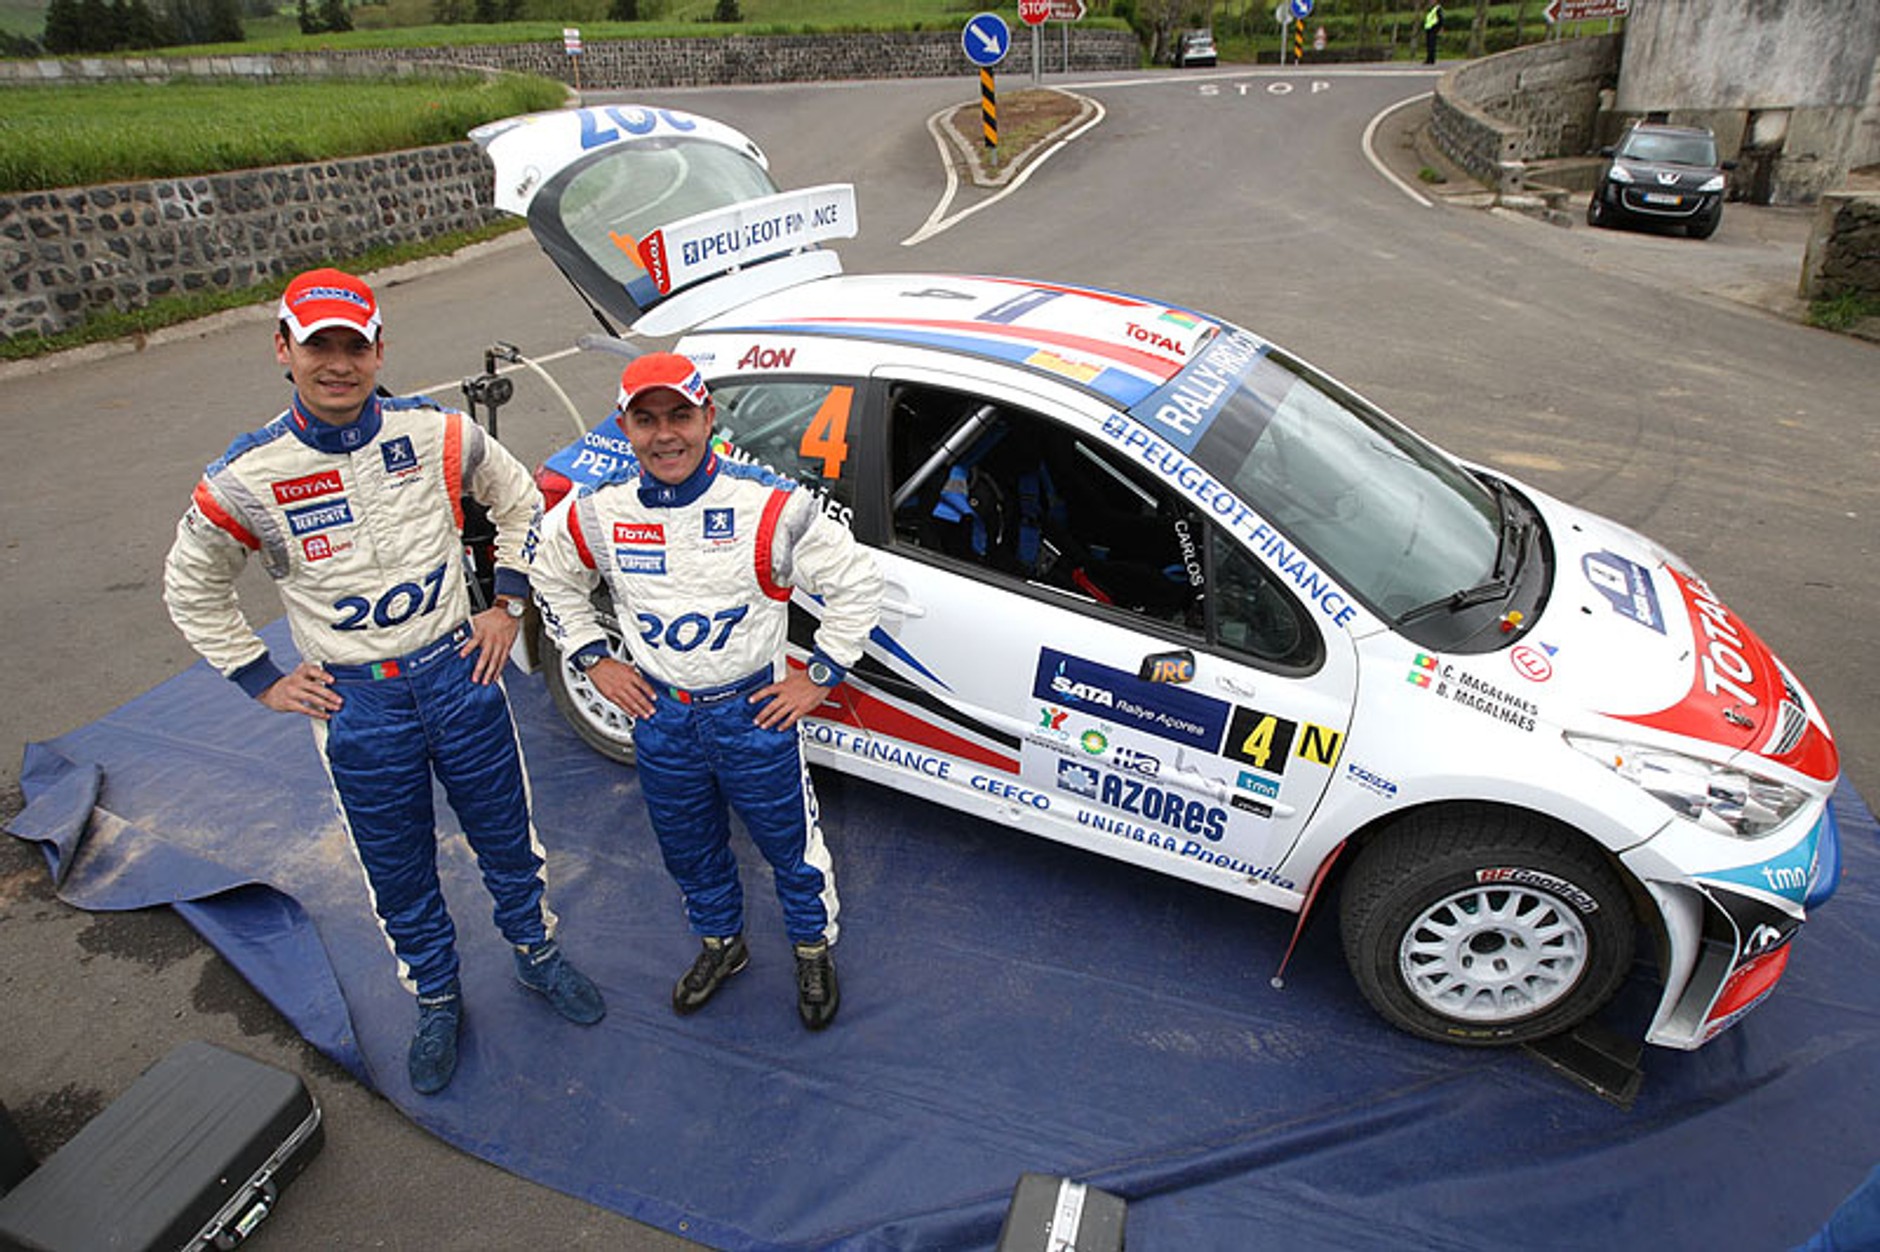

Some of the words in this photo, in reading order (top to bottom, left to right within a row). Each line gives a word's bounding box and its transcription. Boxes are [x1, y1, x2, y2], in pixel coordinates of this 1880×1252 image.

[1199, 81, 1330, 96] STOP
[648, 235, 664, 290] TOTAL
[1126, 322, 1187, 357] TOTAL
[799, 385, 855, 479] 4
[276, 479, 340, 499] TOTAL
[616, 526, 662, 541] TOTAL
[1124, 430, 1254, 528] PEUGEOT
[1248, 524, 1357, 628] FINANCE
[1175, 520, 1205, 587] CARLOS
[330, 562, 448, 631] 207
[636, 604, 750, 652] 207
[1686, 578, 1759, 707] TOTAL
[1050, 676, 1114, 707] SATA
[852, 737, 952, 779] FINANCE
[1242, 715, 1278, 768] 4
[1299, 725, 1340, 766] N
[969, 775, 1052, 810] GEFCO
[1762, 865, 1807, 891] tmn
